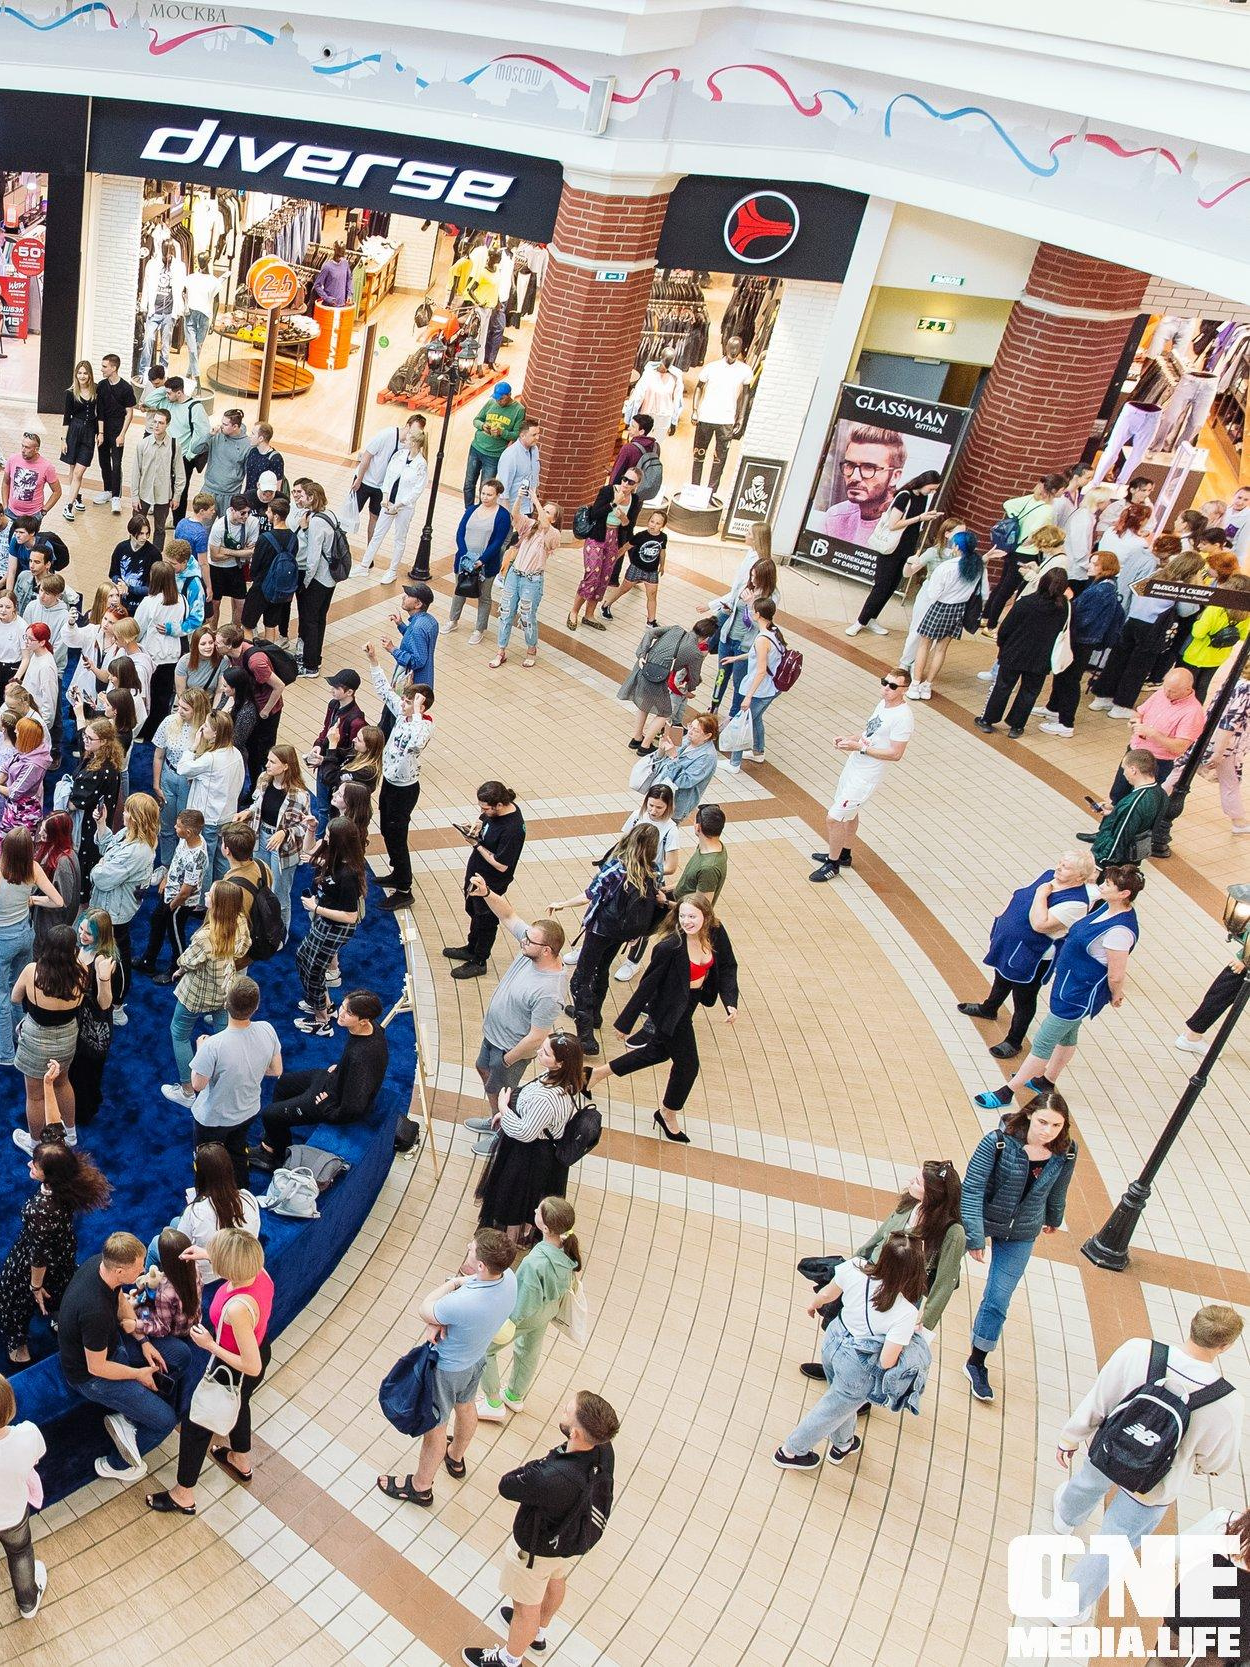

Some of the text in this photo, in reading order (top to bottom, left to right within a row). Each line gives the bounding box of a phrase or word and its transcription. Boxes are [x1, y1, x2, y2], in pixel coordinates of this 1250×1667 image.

[149, 3, 227, 23] МОСКВА
[139, 118, 518, 212] diverse
[855, 395, 949, 427] GLASSMAN
[915, 422, 943, 434] ОПТИКА
[738, 497, 767, 515] DAKAR
[833, 551, 871, 568] КОЛЛЕКЦИЯ
[854, 550, 877, 561] НОВАЯ
[832, 558, 841, 566] ОТ
[841, 560, 860, 571] DAVID
[1152, 583, 1179, 593] ВЫХОД
[1186, 588, 1215, 597] СКВЕРУ
